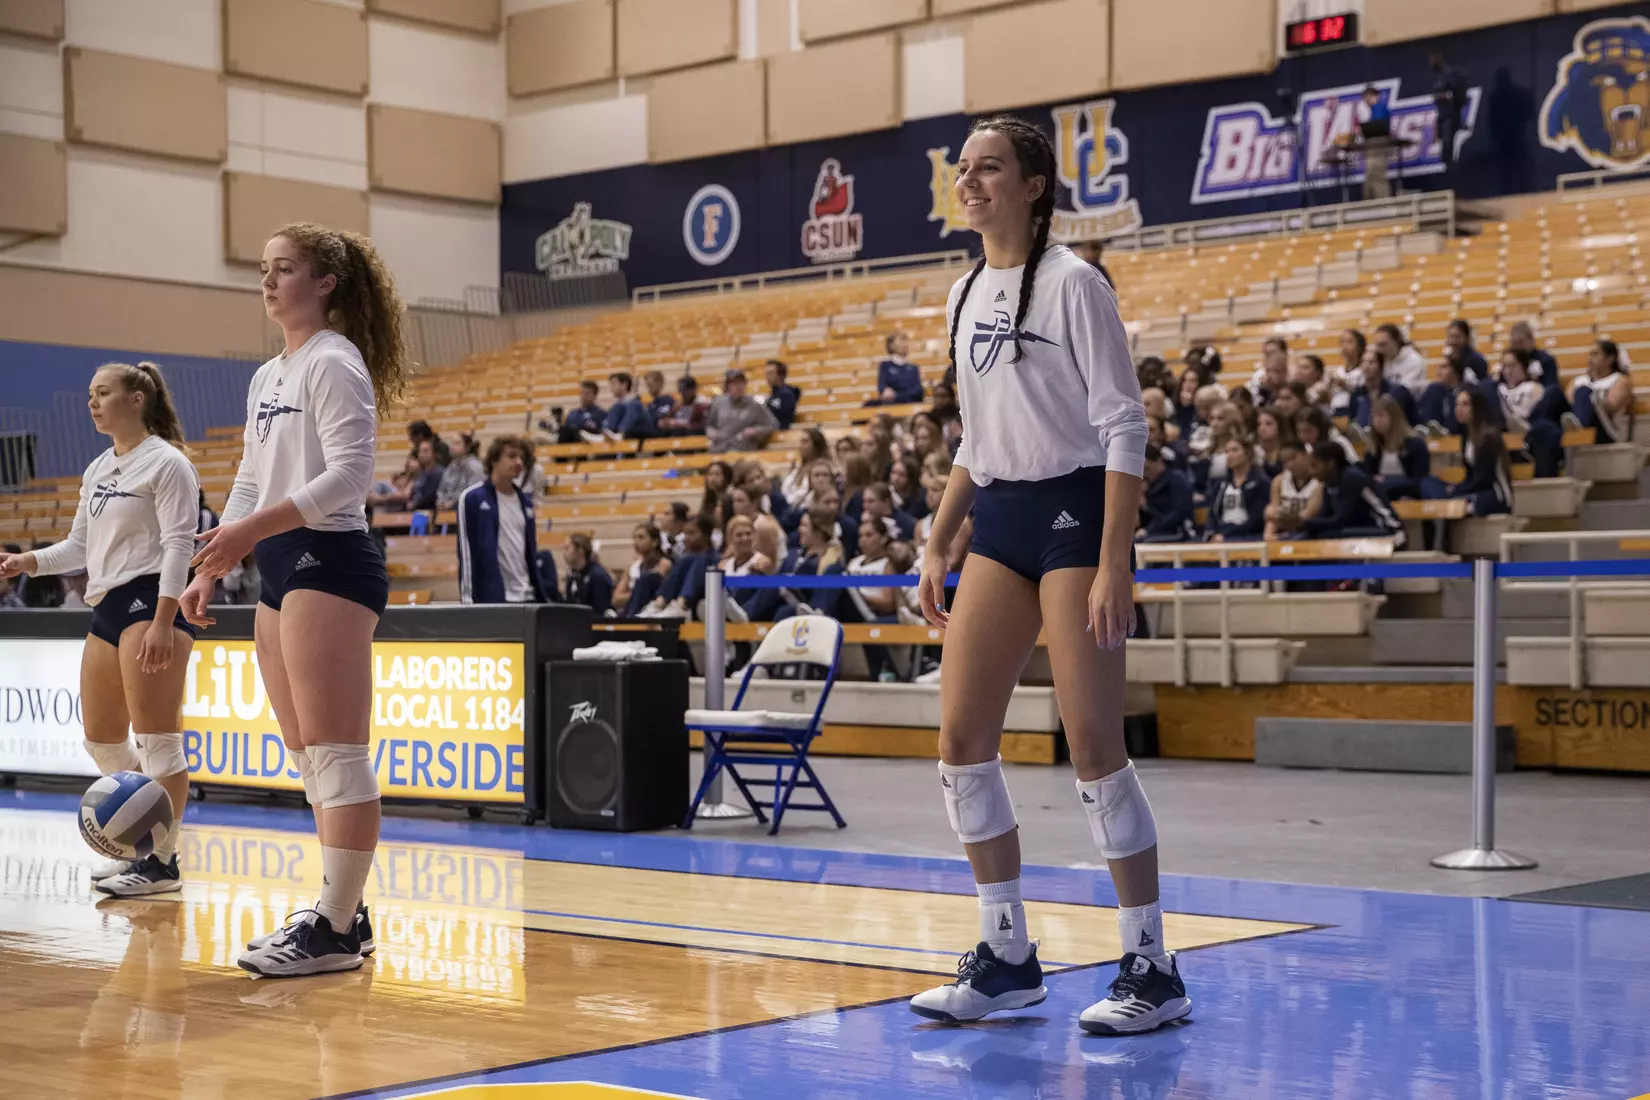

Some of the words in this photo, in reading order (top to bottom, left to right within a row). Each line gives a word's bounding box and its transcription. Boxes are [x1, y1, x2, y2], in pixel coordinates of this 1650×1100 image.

[702, 204, 723, 248] F
[806, 219, 859, 251] CSUN
[1052, 520, 1080, 530] adidas
[181, 645, 277, 721] LiU
[375, 655, 512, 691] LABORERS
[374, 694, 459, 729] LOCAL
[465, 696, 524, 731] 1184
[85, 817, 124, 856] molten
